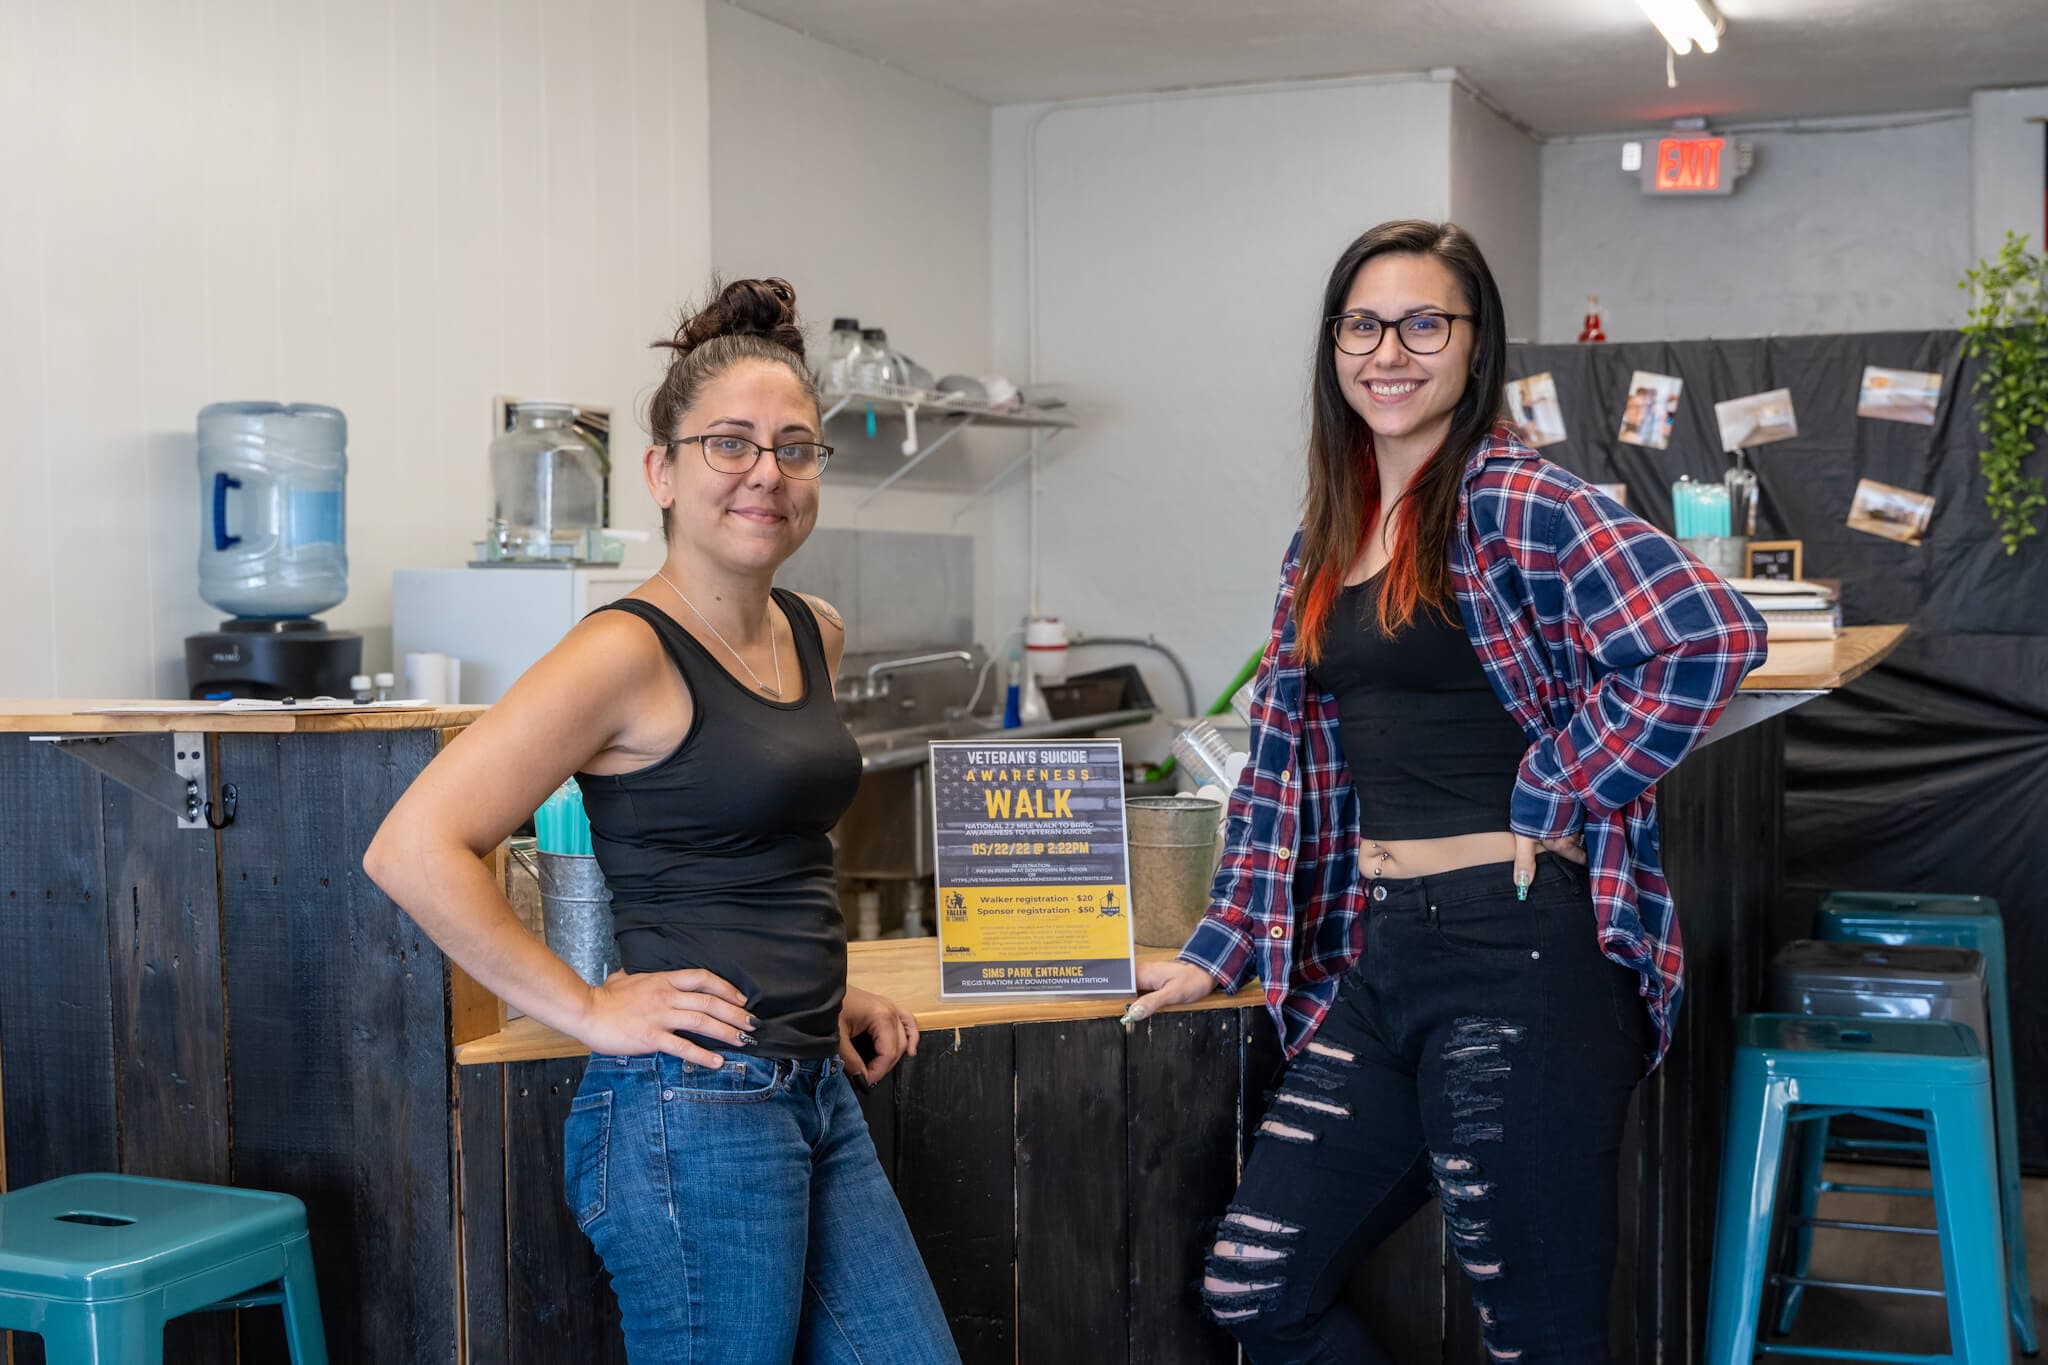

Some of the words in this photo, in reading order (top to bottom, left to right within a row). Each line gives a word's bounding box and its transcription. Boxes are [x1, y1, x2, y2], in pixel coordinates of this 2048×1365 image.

[1655, 138, 1725, 191] EXIT
[967, 751, 1036, 765] VETERAN'S
[1040, 751, 1087, 764] SUICIDE
[966, 769, 1089, 782] AWARENESS
[985, 789, 1073, 819] WALK
[972, 843, 1031, 856] 05/22/22
[1034, 843, 1044, 855] @
[1048, 842, 1089, 854] 2:22PM
[1016, 895, 1068, 905] registration
[1077, 894, 1093, 902] $20
[977, 908, 1014, 916] Sponsor
[1017, 906, 1070, 916] registration
[1078, 906, 1095, 914] $50
[982, 967, 1005, 978] SIMS
[1007, 967, 1032, 977] PARK
[1035, 966, 1083, 977] ENTRANCE
